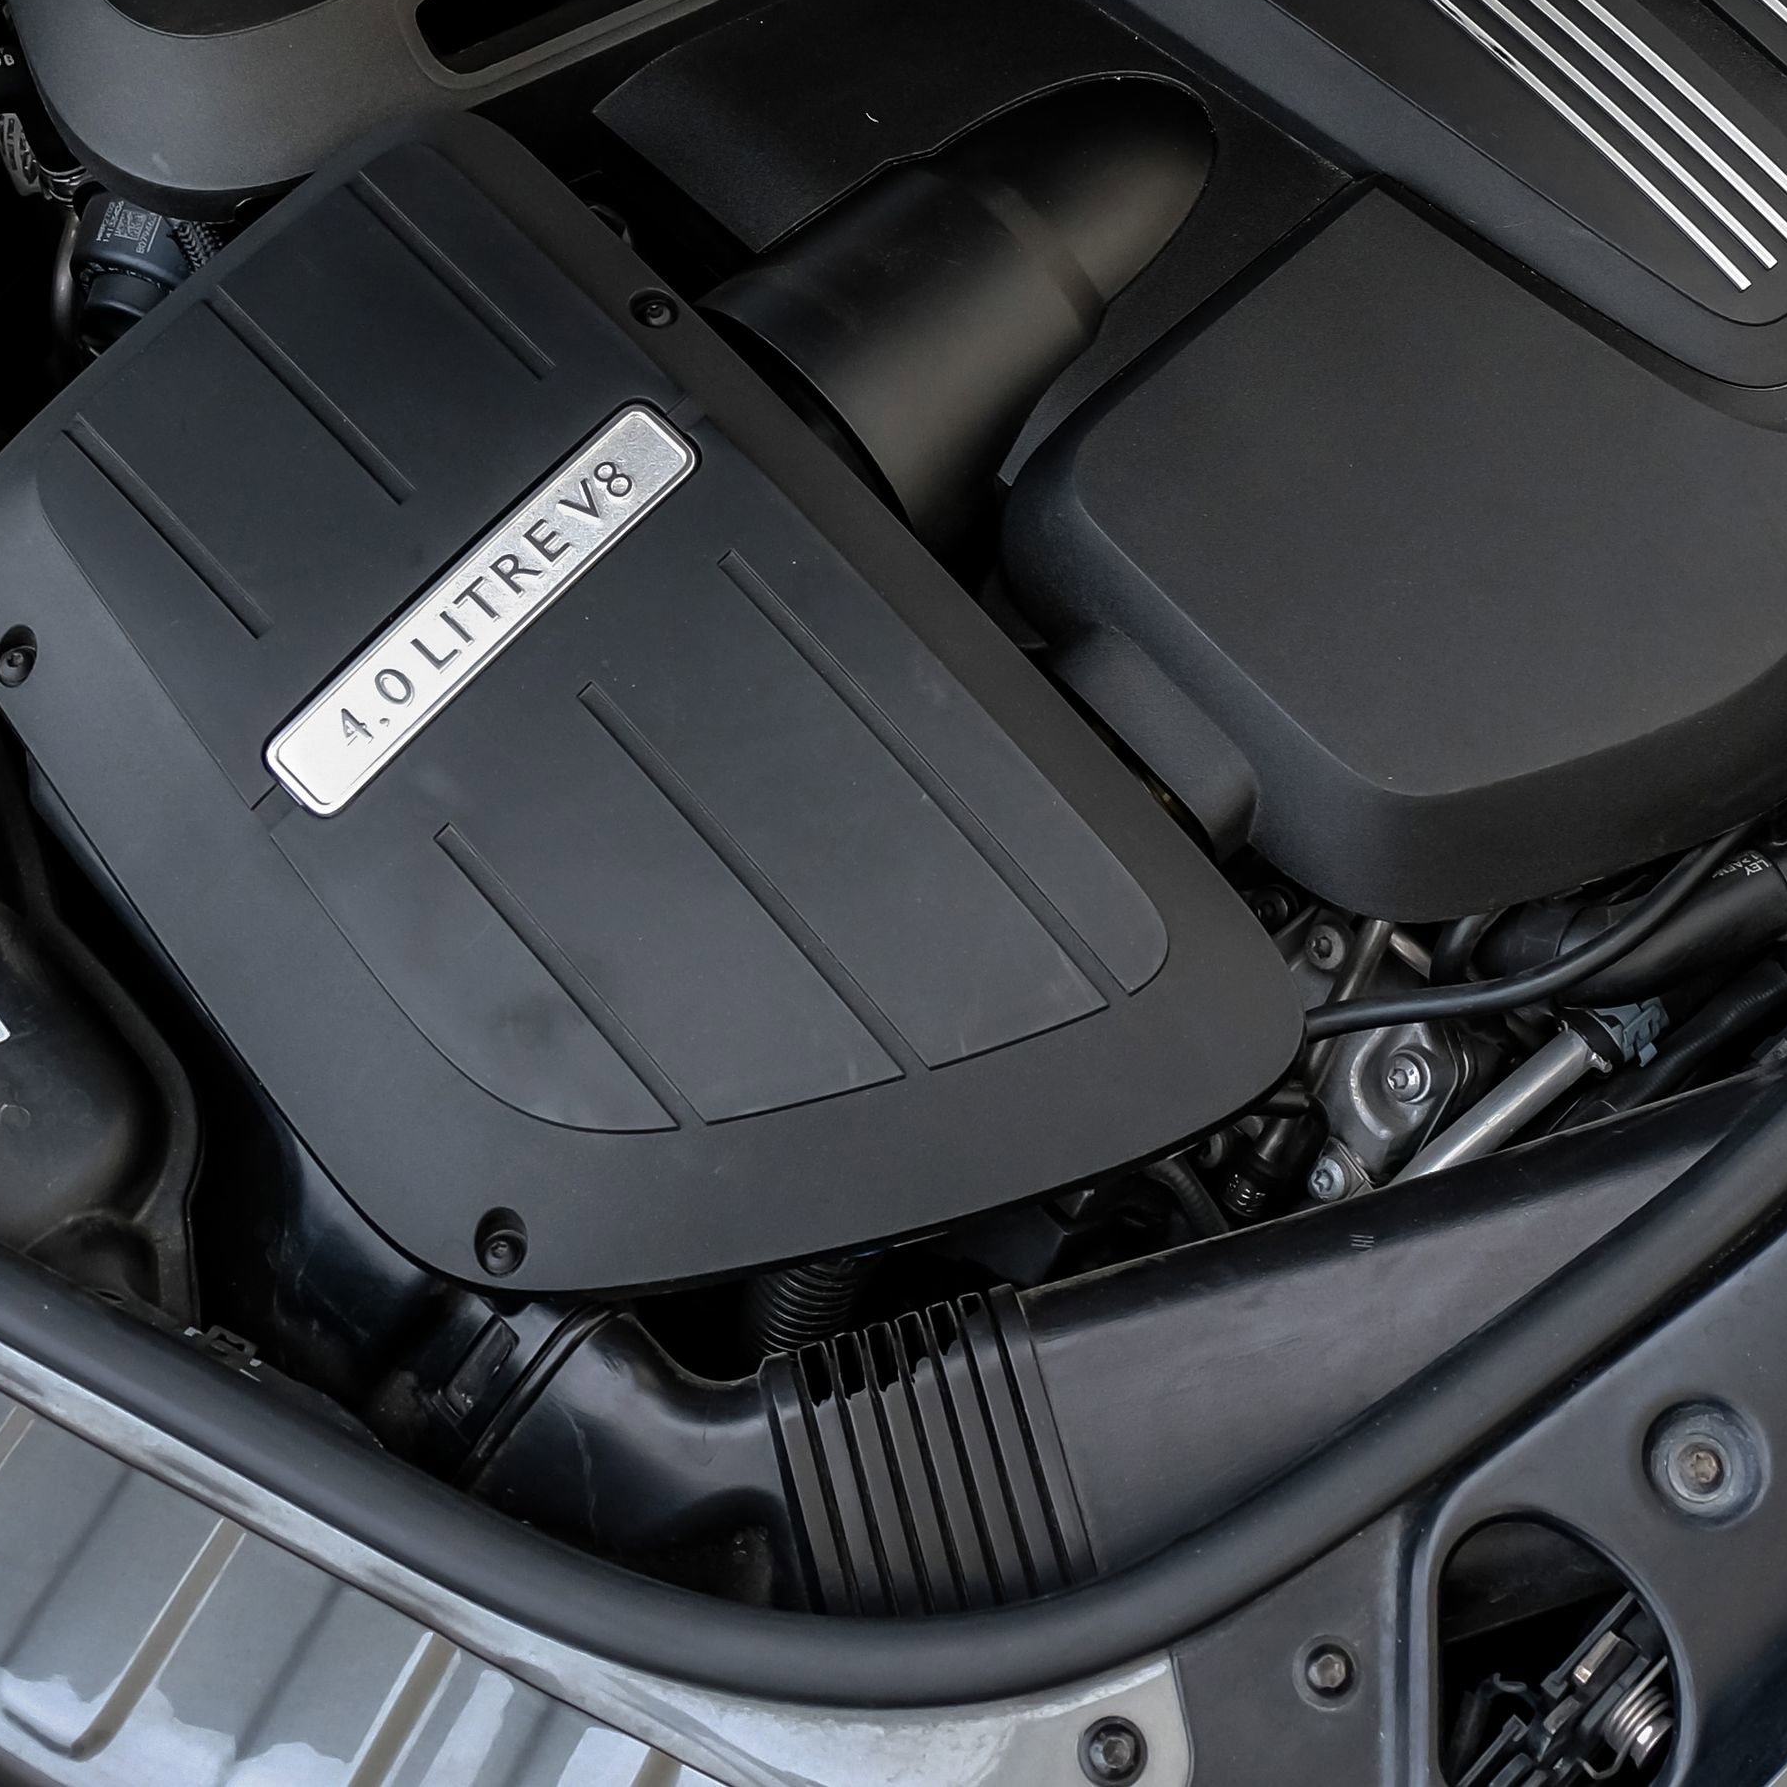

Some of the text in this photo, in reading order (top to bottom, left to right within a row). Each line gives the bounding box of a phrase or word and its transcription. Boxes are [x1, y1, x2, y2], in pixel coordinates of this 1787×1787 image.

[340, 461, 632, 746] 4.0 LITRE V8
